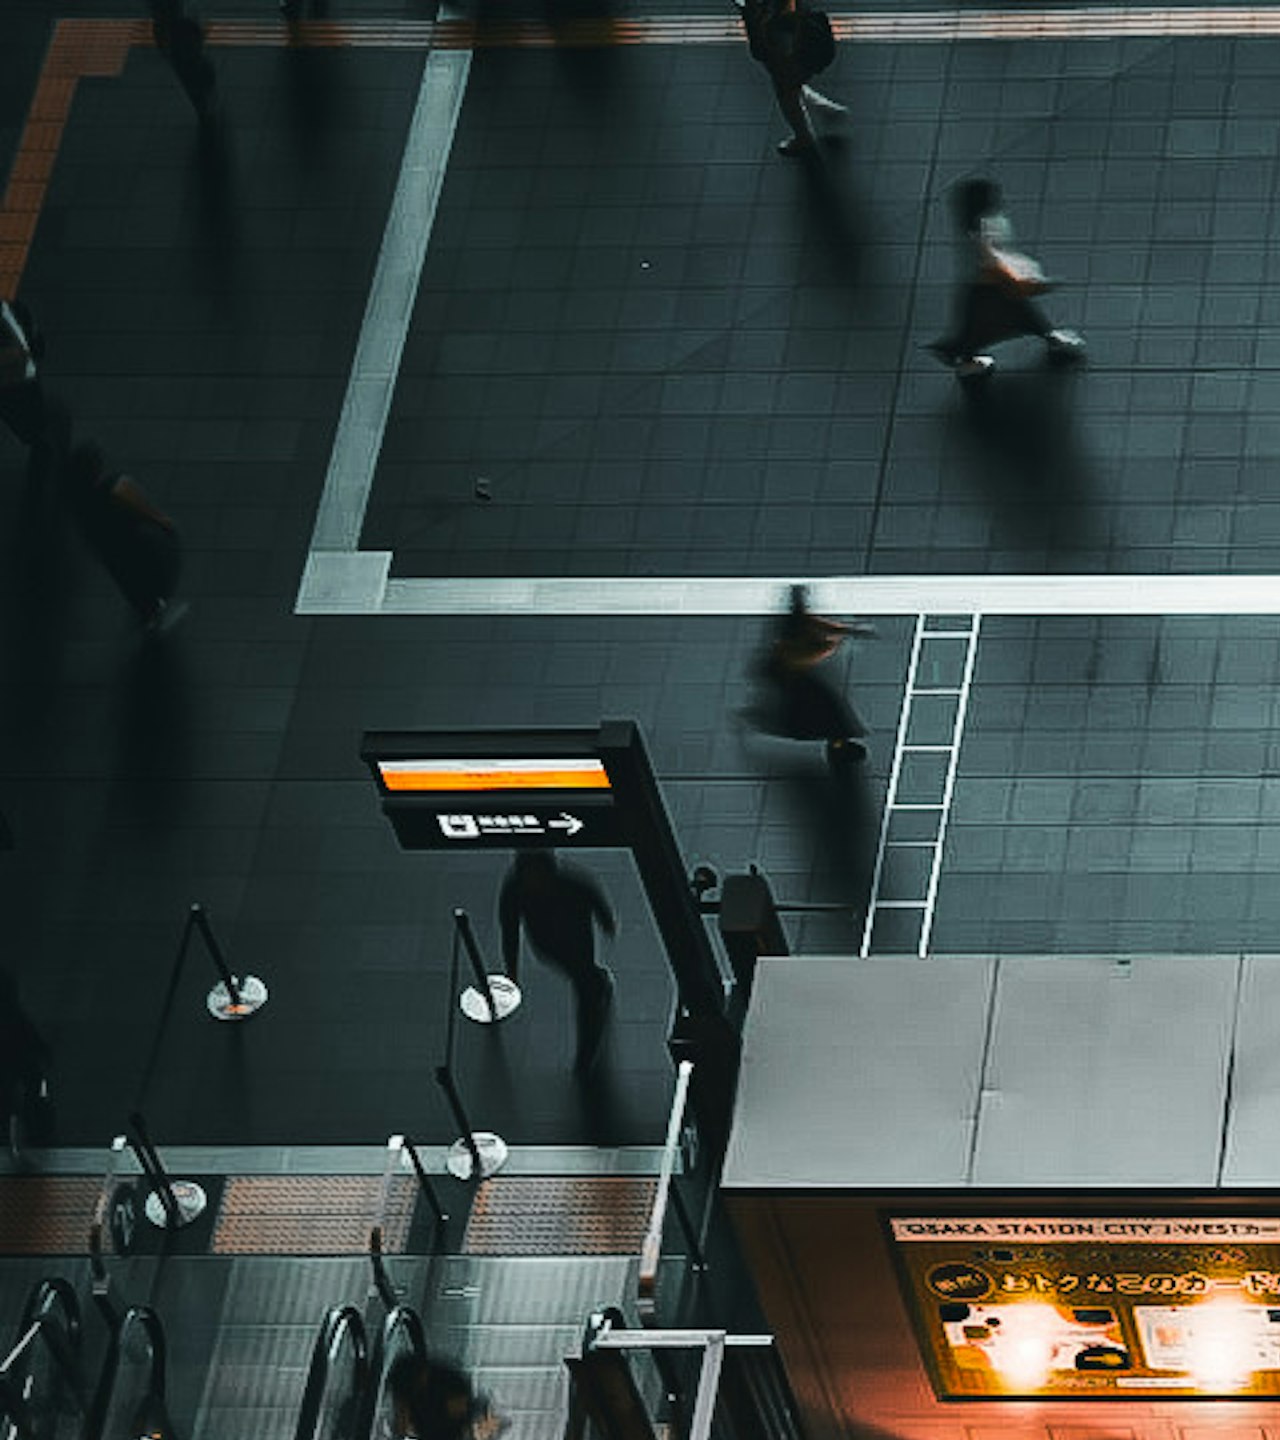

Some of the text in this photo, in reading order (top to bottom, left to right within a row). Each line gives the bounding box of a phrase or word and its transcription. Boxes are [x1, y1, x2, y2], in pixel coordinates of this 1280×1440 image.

[906, 1223, 988, 1236] OSAKA
[996, 1223, 1094, 1236] STATION
[1103, 1223, 1153, 1236] CITY
